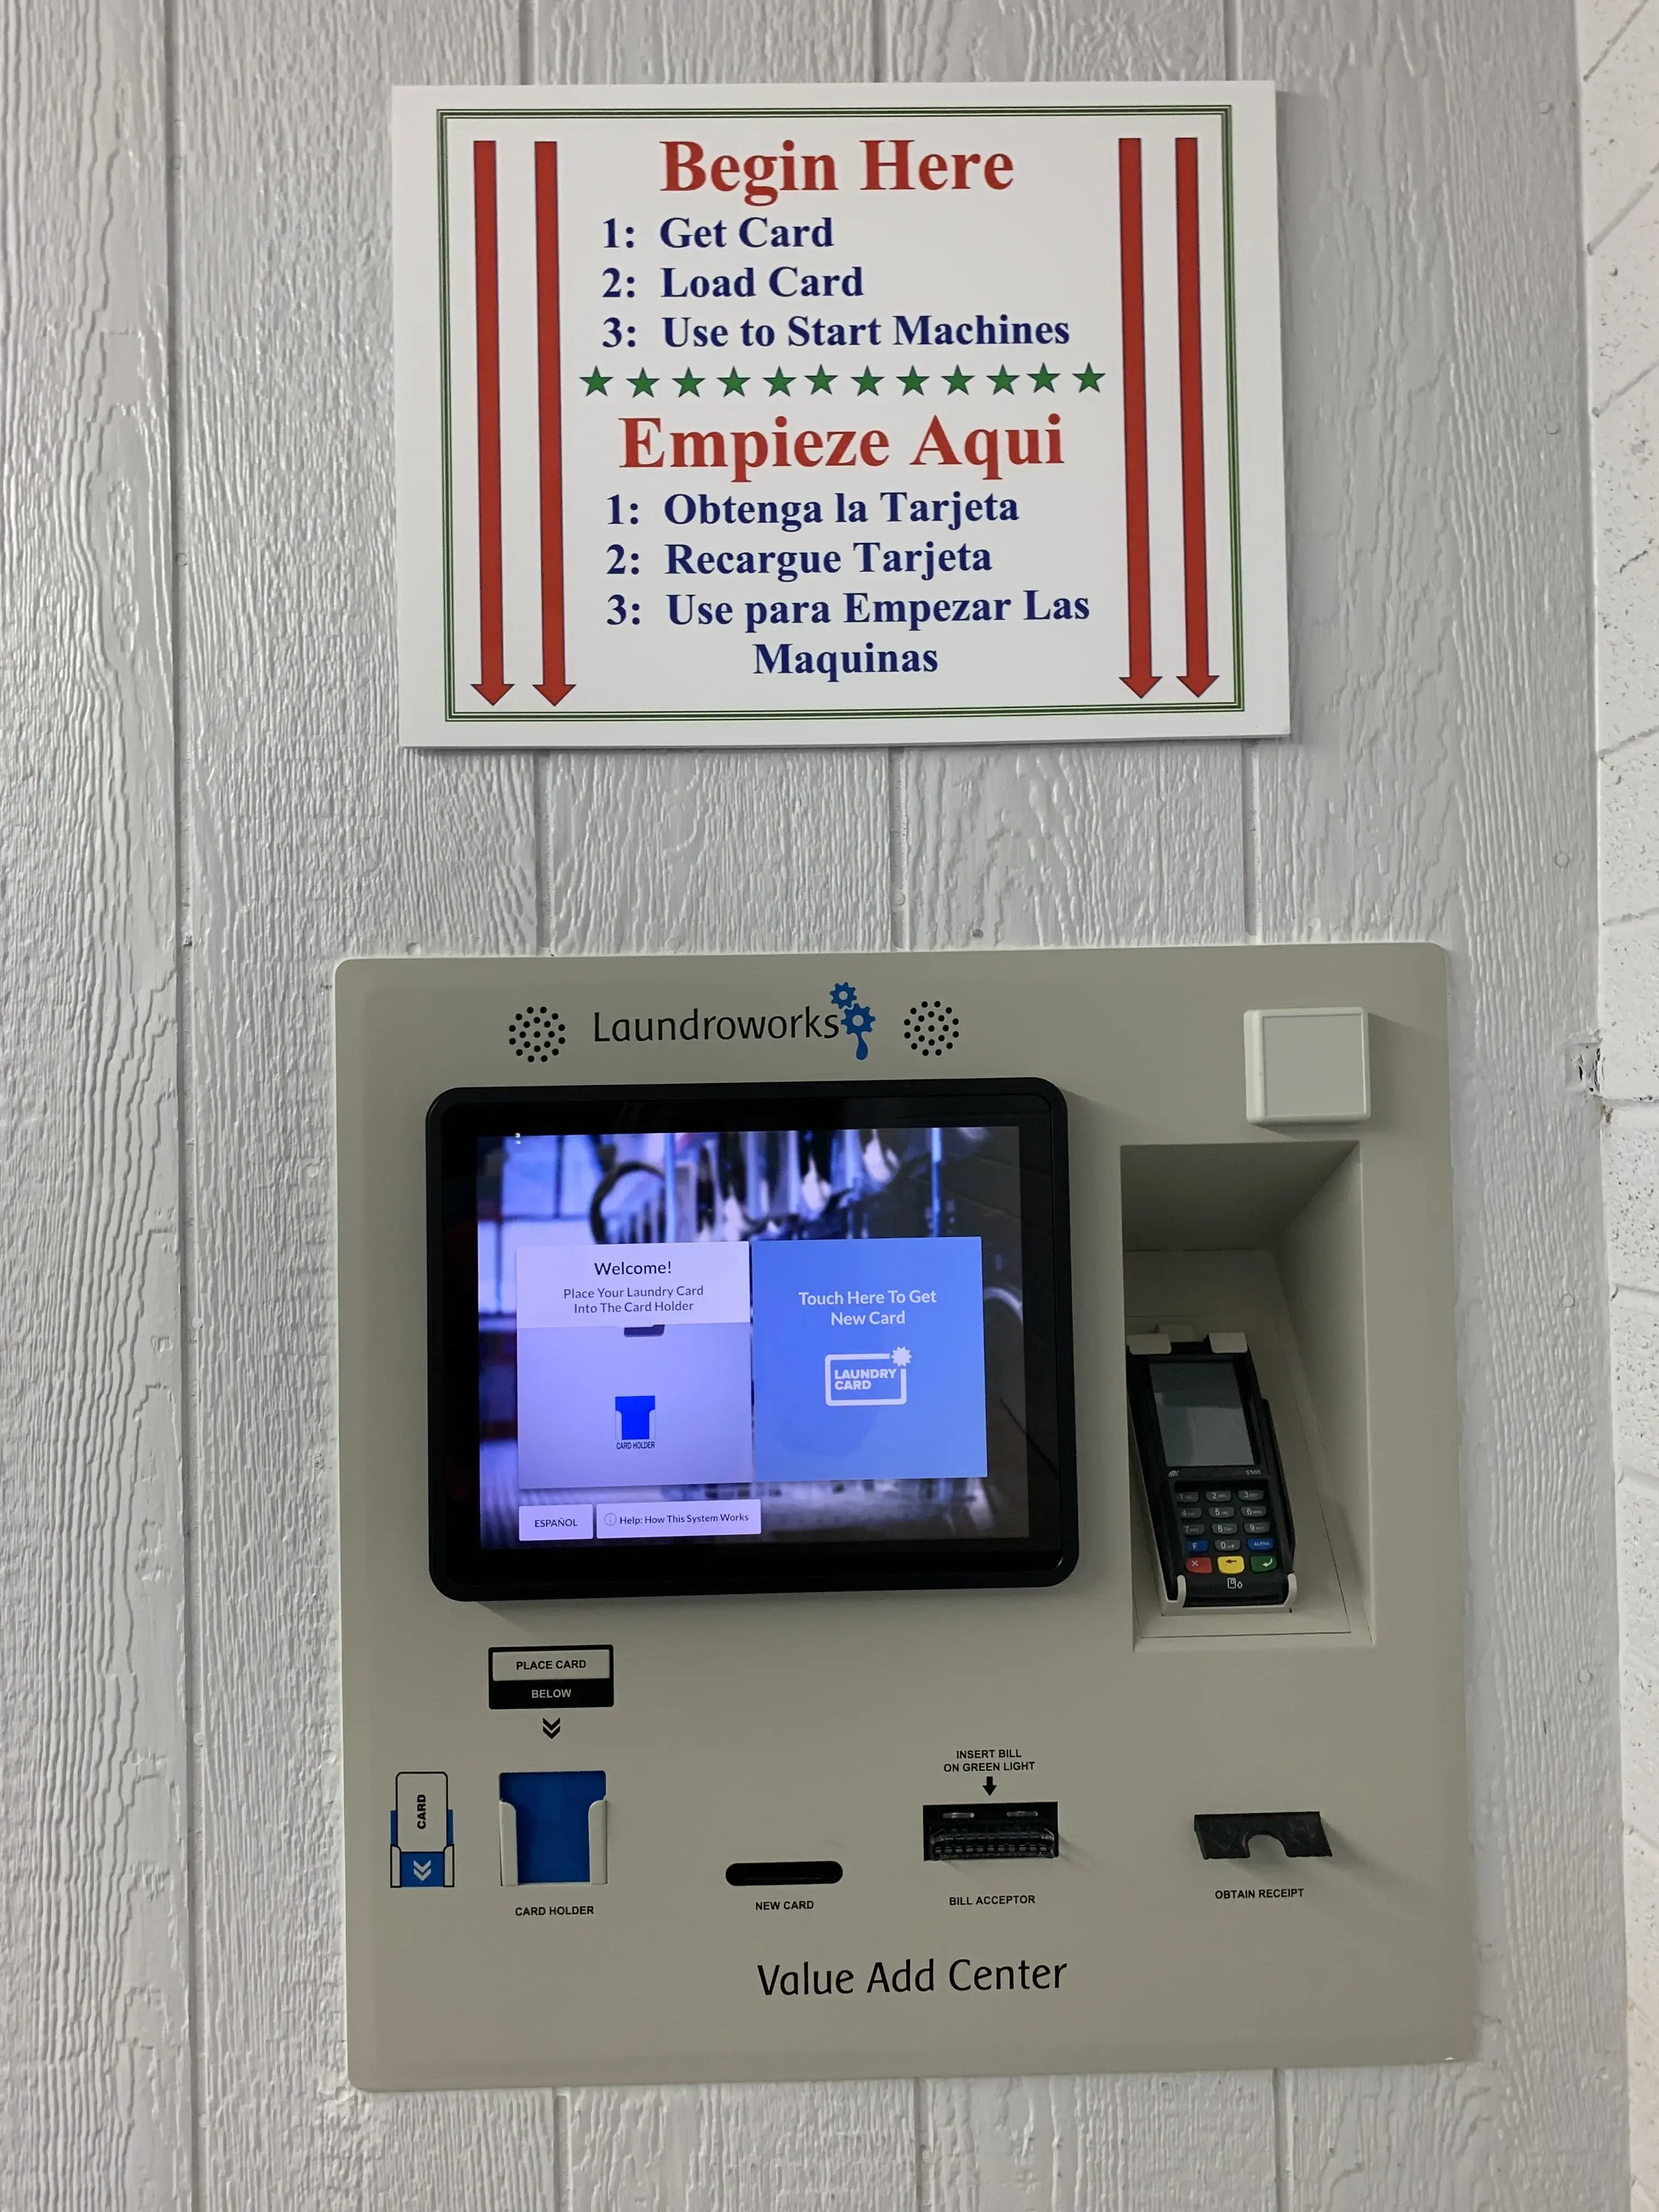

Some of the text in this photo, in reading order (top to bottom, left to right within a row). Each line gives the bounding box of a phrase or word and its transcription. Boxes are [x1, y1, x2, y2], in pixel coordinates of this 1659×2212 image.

[659, 140, 1013, 206] Begin Here
[603, 217, 834, 248] 1: Get Card
[603, 267, 864, 298] 2: Load Card
[602, 314, 1069, 347] 3: Use to Start Machines
[618, 414, 1064, 482] Empieze Aqui
[607, 491, 1019, 532] 1: Obtenga la Tarjeta
[607, 541, 992, 582] 2: Recargue Tarjeta
[607, 590, 1089, 633] 3: Use para Empezar Las
[753, 642, 938, 682] Maquinas
[595, 1006, 839, 1041] Laundroworks
[594, 1261, 670, 1275] Welcome!
[565, 1285, 703, 1299] Place Your Laundry Card
[798, 1290, 936, 1305] Touch Here To Get
[575, 1301, 693, 1313] Into The Card Holder
[832, 1311, 905, 1325] New Card
[834, 1369, 896, 1379] LAUNDRY
[834, 1380, 871, 1390] CARD
[535, 1518, 577, 1527] ESPAÑOL
[620, 1516, 642, 1525] Help:
[687, 1515, 718, 1523] System
[517, 1660, 586, 1669] PLACE CARD
[532, 1689, 571, 1698] BELOW
[957, 1750, 1022, 1758] INSERT BILL
[944, 1762, 1035, 1772] ON GREEN LIGHT
[417, 1795, 426, 1829] CARD
[950, 1895, 1035, 1905] BILL ACCEPTOR
[1215, 1888, 1304, 1899] OBTAIN RECEIPT
[515, 1906, 594, 1916] CARD HOLDER
[756, 1901, 814, 1910] NEW CARD
[758, 1958, 1067, 1995] Value Add Center
